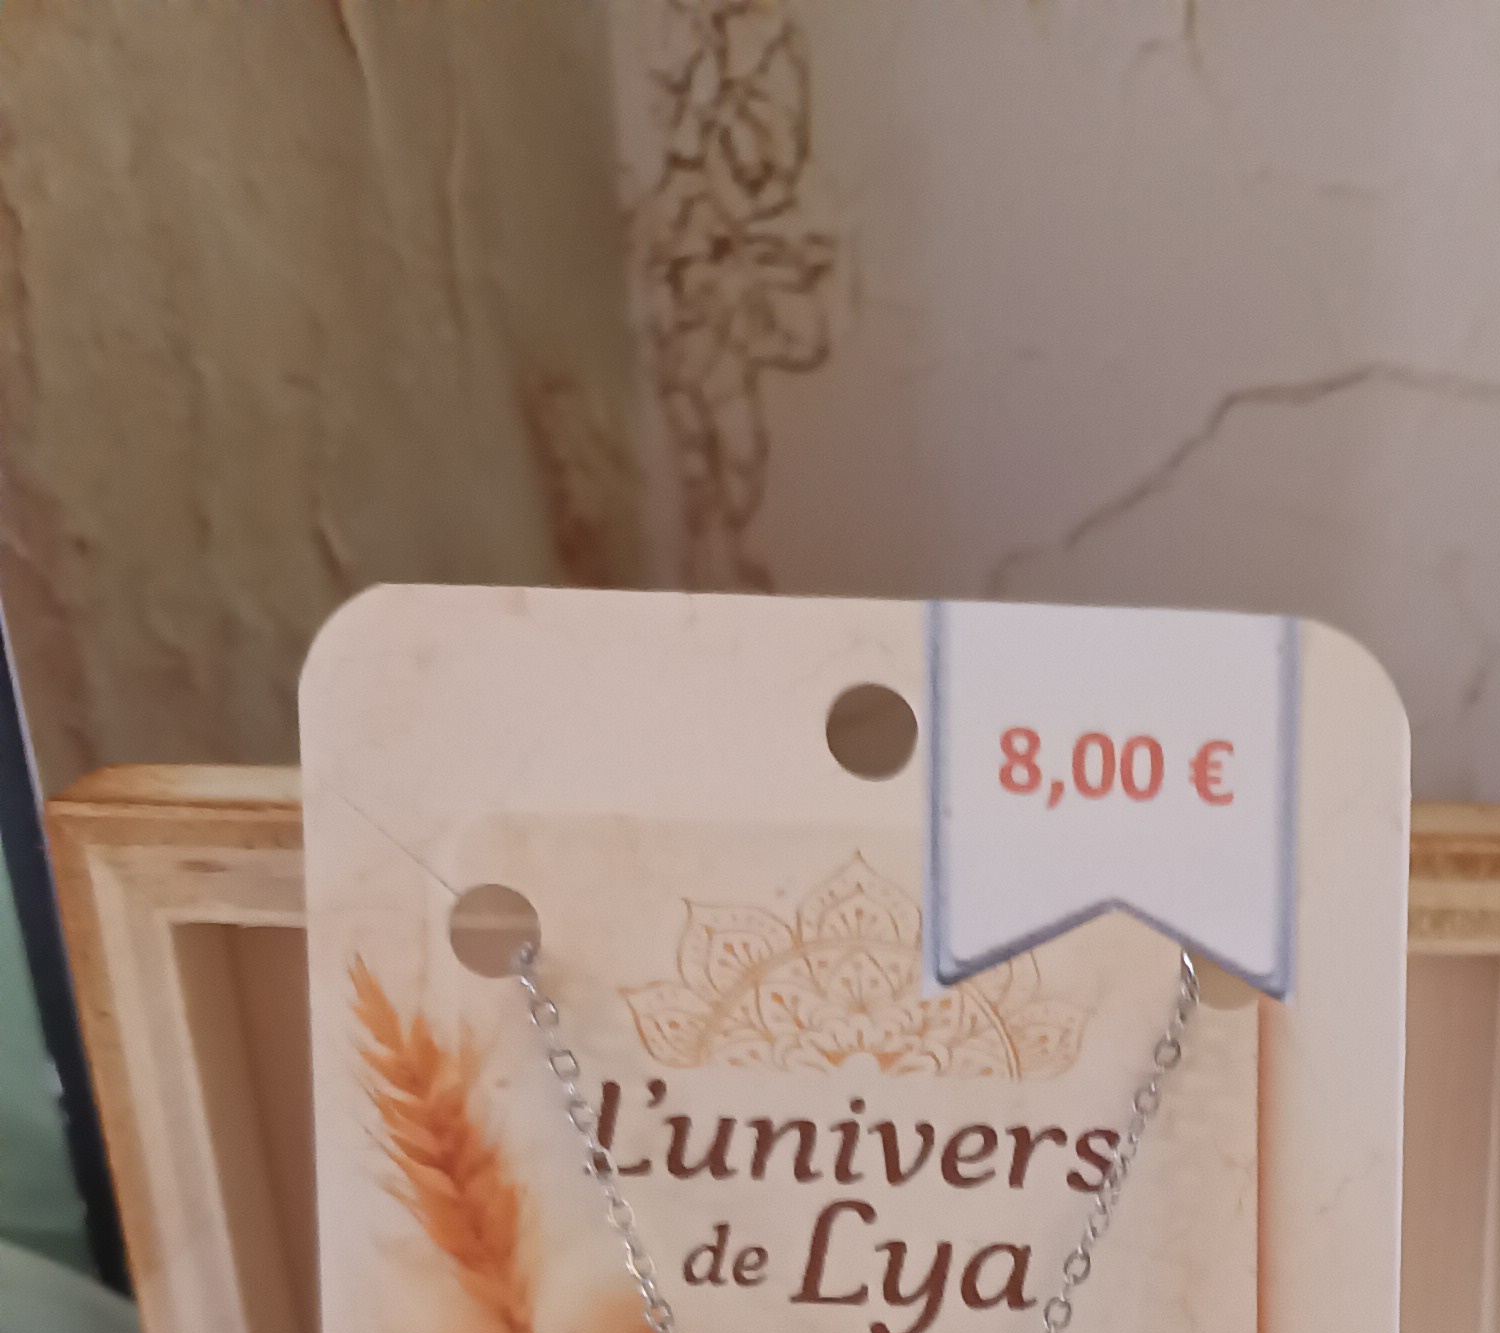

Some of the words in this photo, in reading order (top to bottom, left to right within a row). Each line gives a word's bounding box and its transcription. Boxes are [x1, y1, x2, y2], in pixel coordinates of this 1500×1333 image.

[999, 726, 1164, 809] 8,00
[1188, 739, 1234, 806] €
[682, 1221, 768, 1287] de
